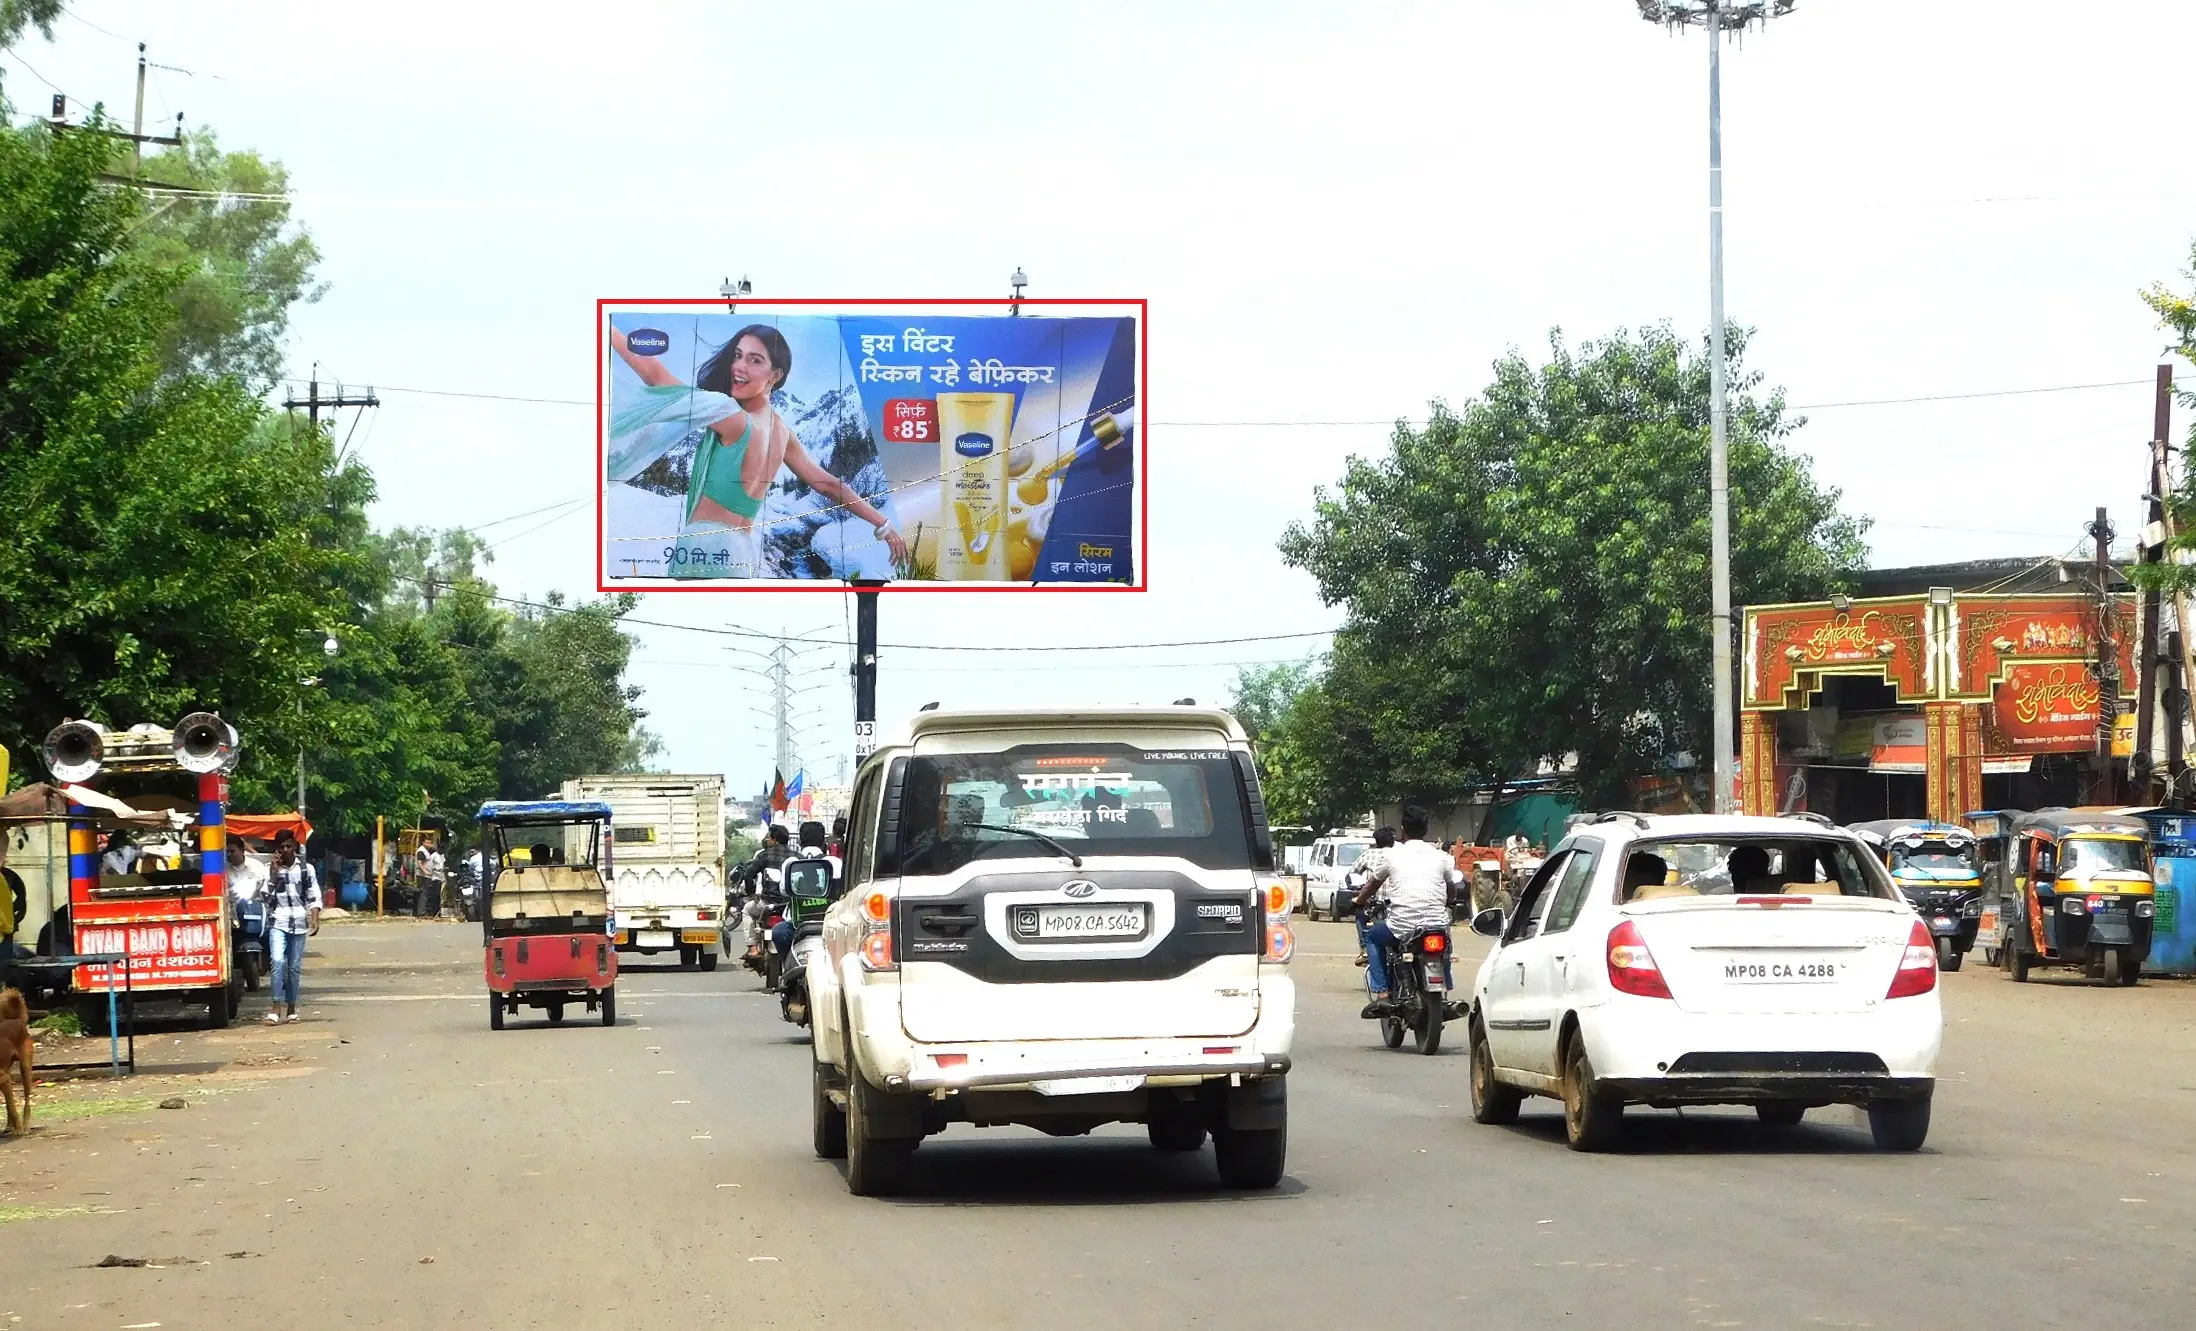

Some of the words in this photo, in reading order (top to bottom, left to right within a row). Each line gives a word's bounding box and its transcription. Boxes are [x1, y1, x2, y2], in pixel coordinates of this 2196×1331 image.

[630, 336, 667, 347] Vaseline
[860, 334, 896, 356] इस
[902, 327, 956, 353] विंटर
[860, 357, 923, 383] स्किन
[929, 358, 961, 387] रहे
[958, 440, 991, 449] Vaseline
[663, 546, 689, 565] 90
[1050, 562, 1071, 575] इन
[1074, 558, 1113, 575] लोशन
[1143, 752, 1161, 760] LIVE
[1190, 752, 1206, 760] LIVE
[1197, 904, 1241, 917] SCORPIO
[128, 927, 169, 956] BAND
[171, 924, 215, 955] GUNA
[156, 954, 214, 968] वंशकार
[1725, 964, 1766, 978] MP08
[1772, 964, 1793, 977] CA
[1798, 964, 1835, 977] 4288
